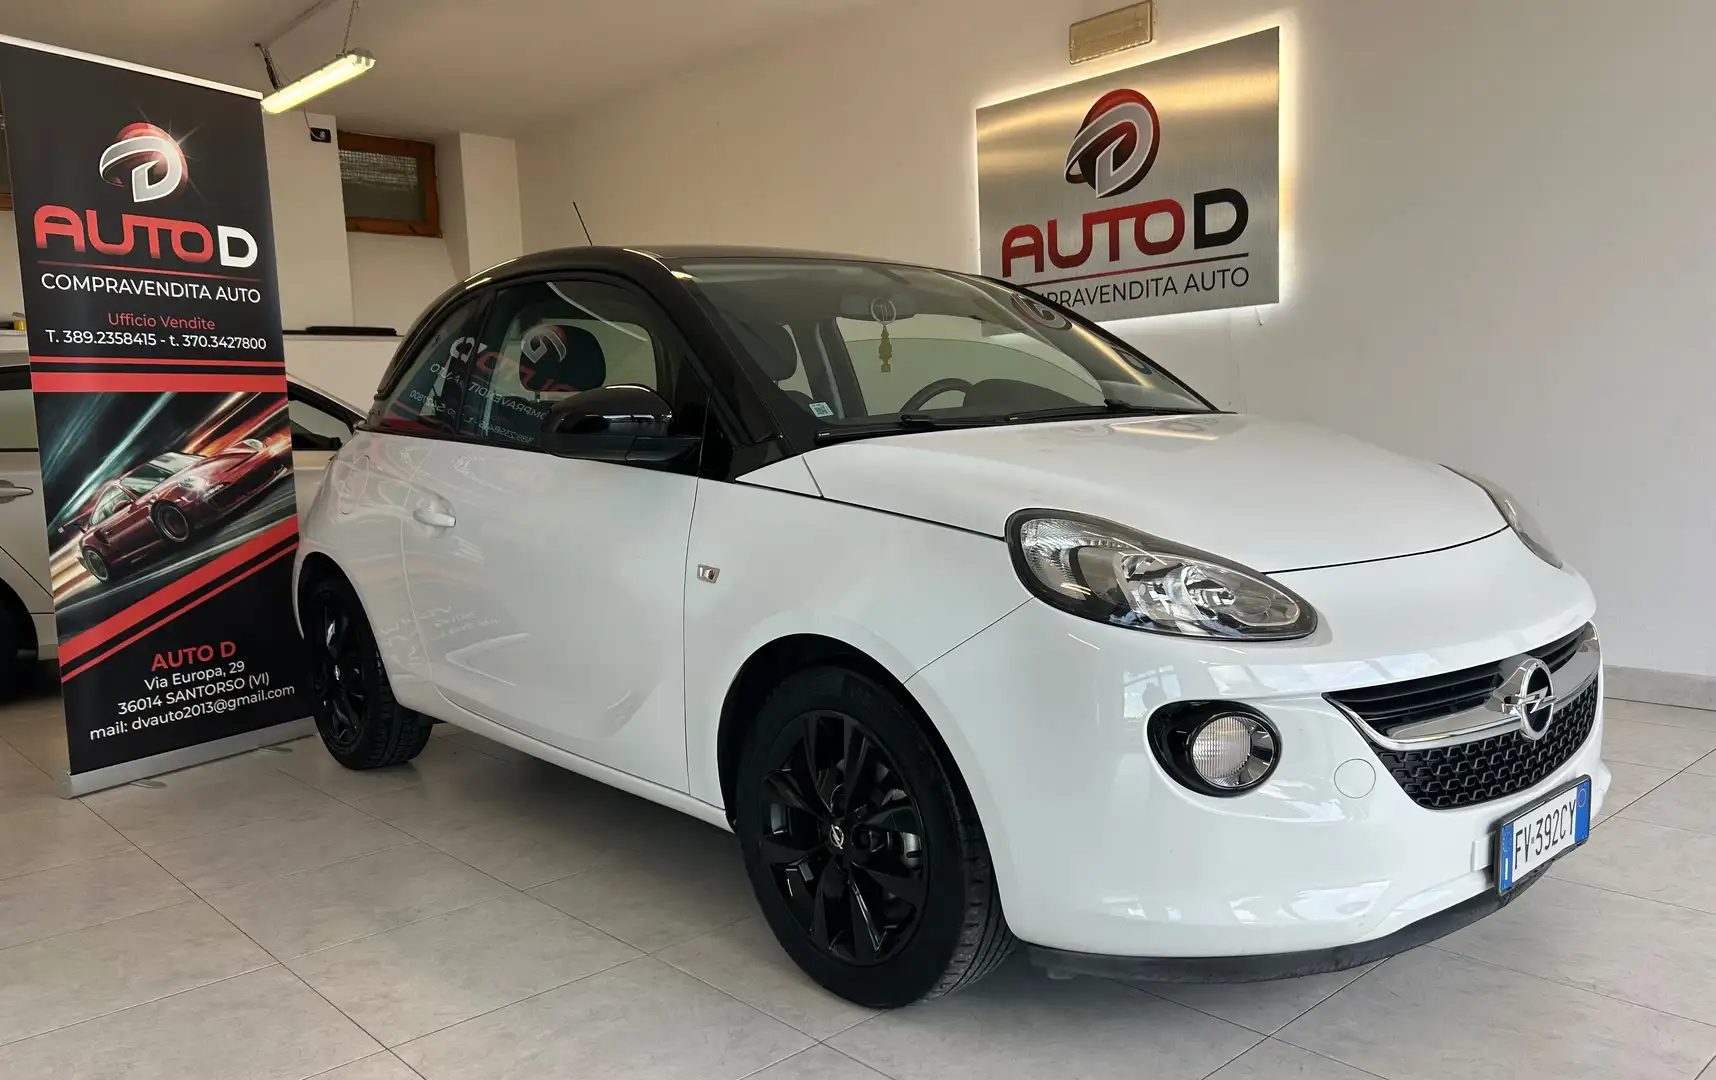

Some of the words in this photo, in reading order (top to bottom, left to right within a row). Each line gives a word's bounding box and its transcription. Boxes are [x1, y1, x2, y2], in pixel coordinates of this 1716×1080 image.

[33, 204, 214, 263] AUTO
[216, 224, 259, 269] D
[1001, 198, 1186, 278] AUTO
[1193, 187, 1250, 251] D
[40, 272, 213, 301] COMPRAVENDITA
[214, 285, 262, 304] AUTO
[1041, 275, 1179, 308] PRAVENDITA
[1183, 266, 1250, 295] AUTO
[44, 329, 60, 344] T.
[62, 330, 157, 347] 389.2358415
[168, 335, 180, 348] t.
[181, 334, 267, 351] 370.3427800
[107, 312, 157, 329] Ufficio
[159, 315, 217, 331] Vendite
[150, 644, 215, 672] AUTO
[220, 641, 237, 658] D
[117, 696, 163, 716] 36014
[166, 677, 246, 705] SANTORSO
[249, 671, 271, 690] (VI)
[144, 674, 168, 692] Via
[172, 666, 227, 687] Europa,
[229, 660, 245, 675] 29
[89, 720, 129, 741] mail:
[131, 685, 295, 731] dvauto2013@gmail.com
